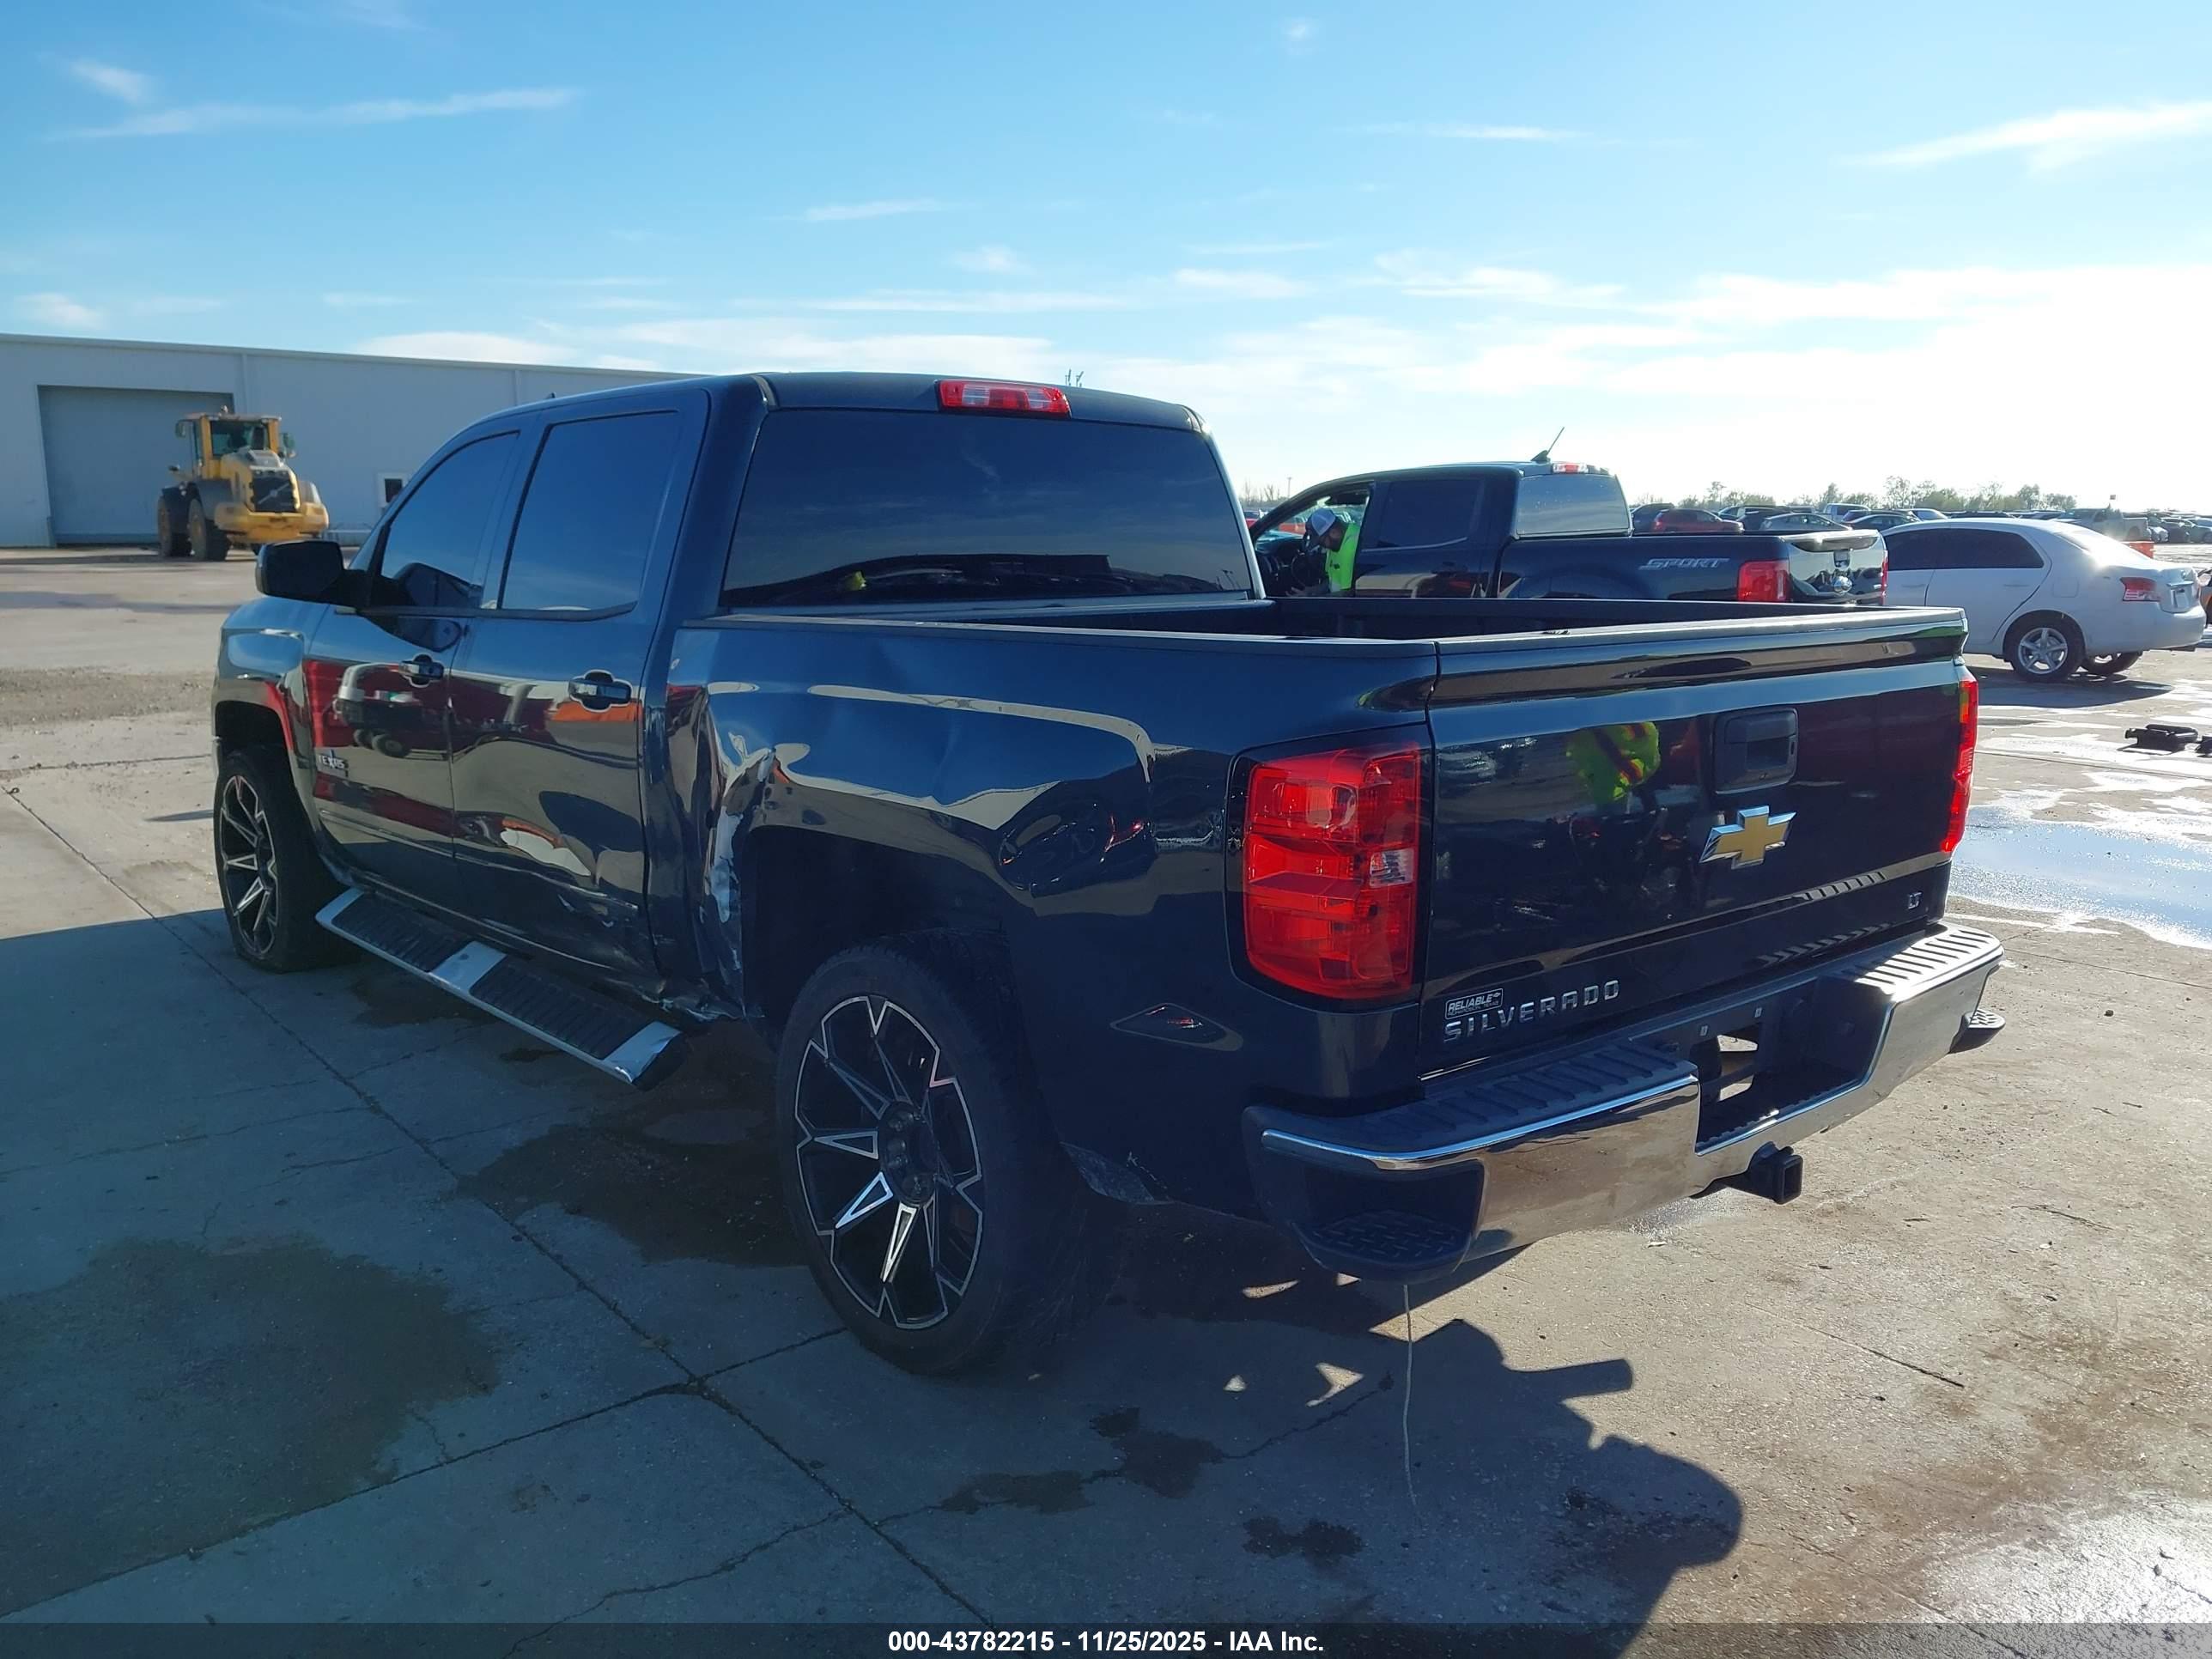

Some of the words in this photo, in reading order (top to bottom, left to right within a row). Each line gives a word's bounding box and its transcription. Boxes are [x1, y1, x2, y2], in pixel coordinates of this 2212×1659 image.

[1638, 557, 1730, 570] SPORT
[1443, 980, 1620, 1043] SILVERADO
[1448, 994, 1493, 1014] RELIABLE
